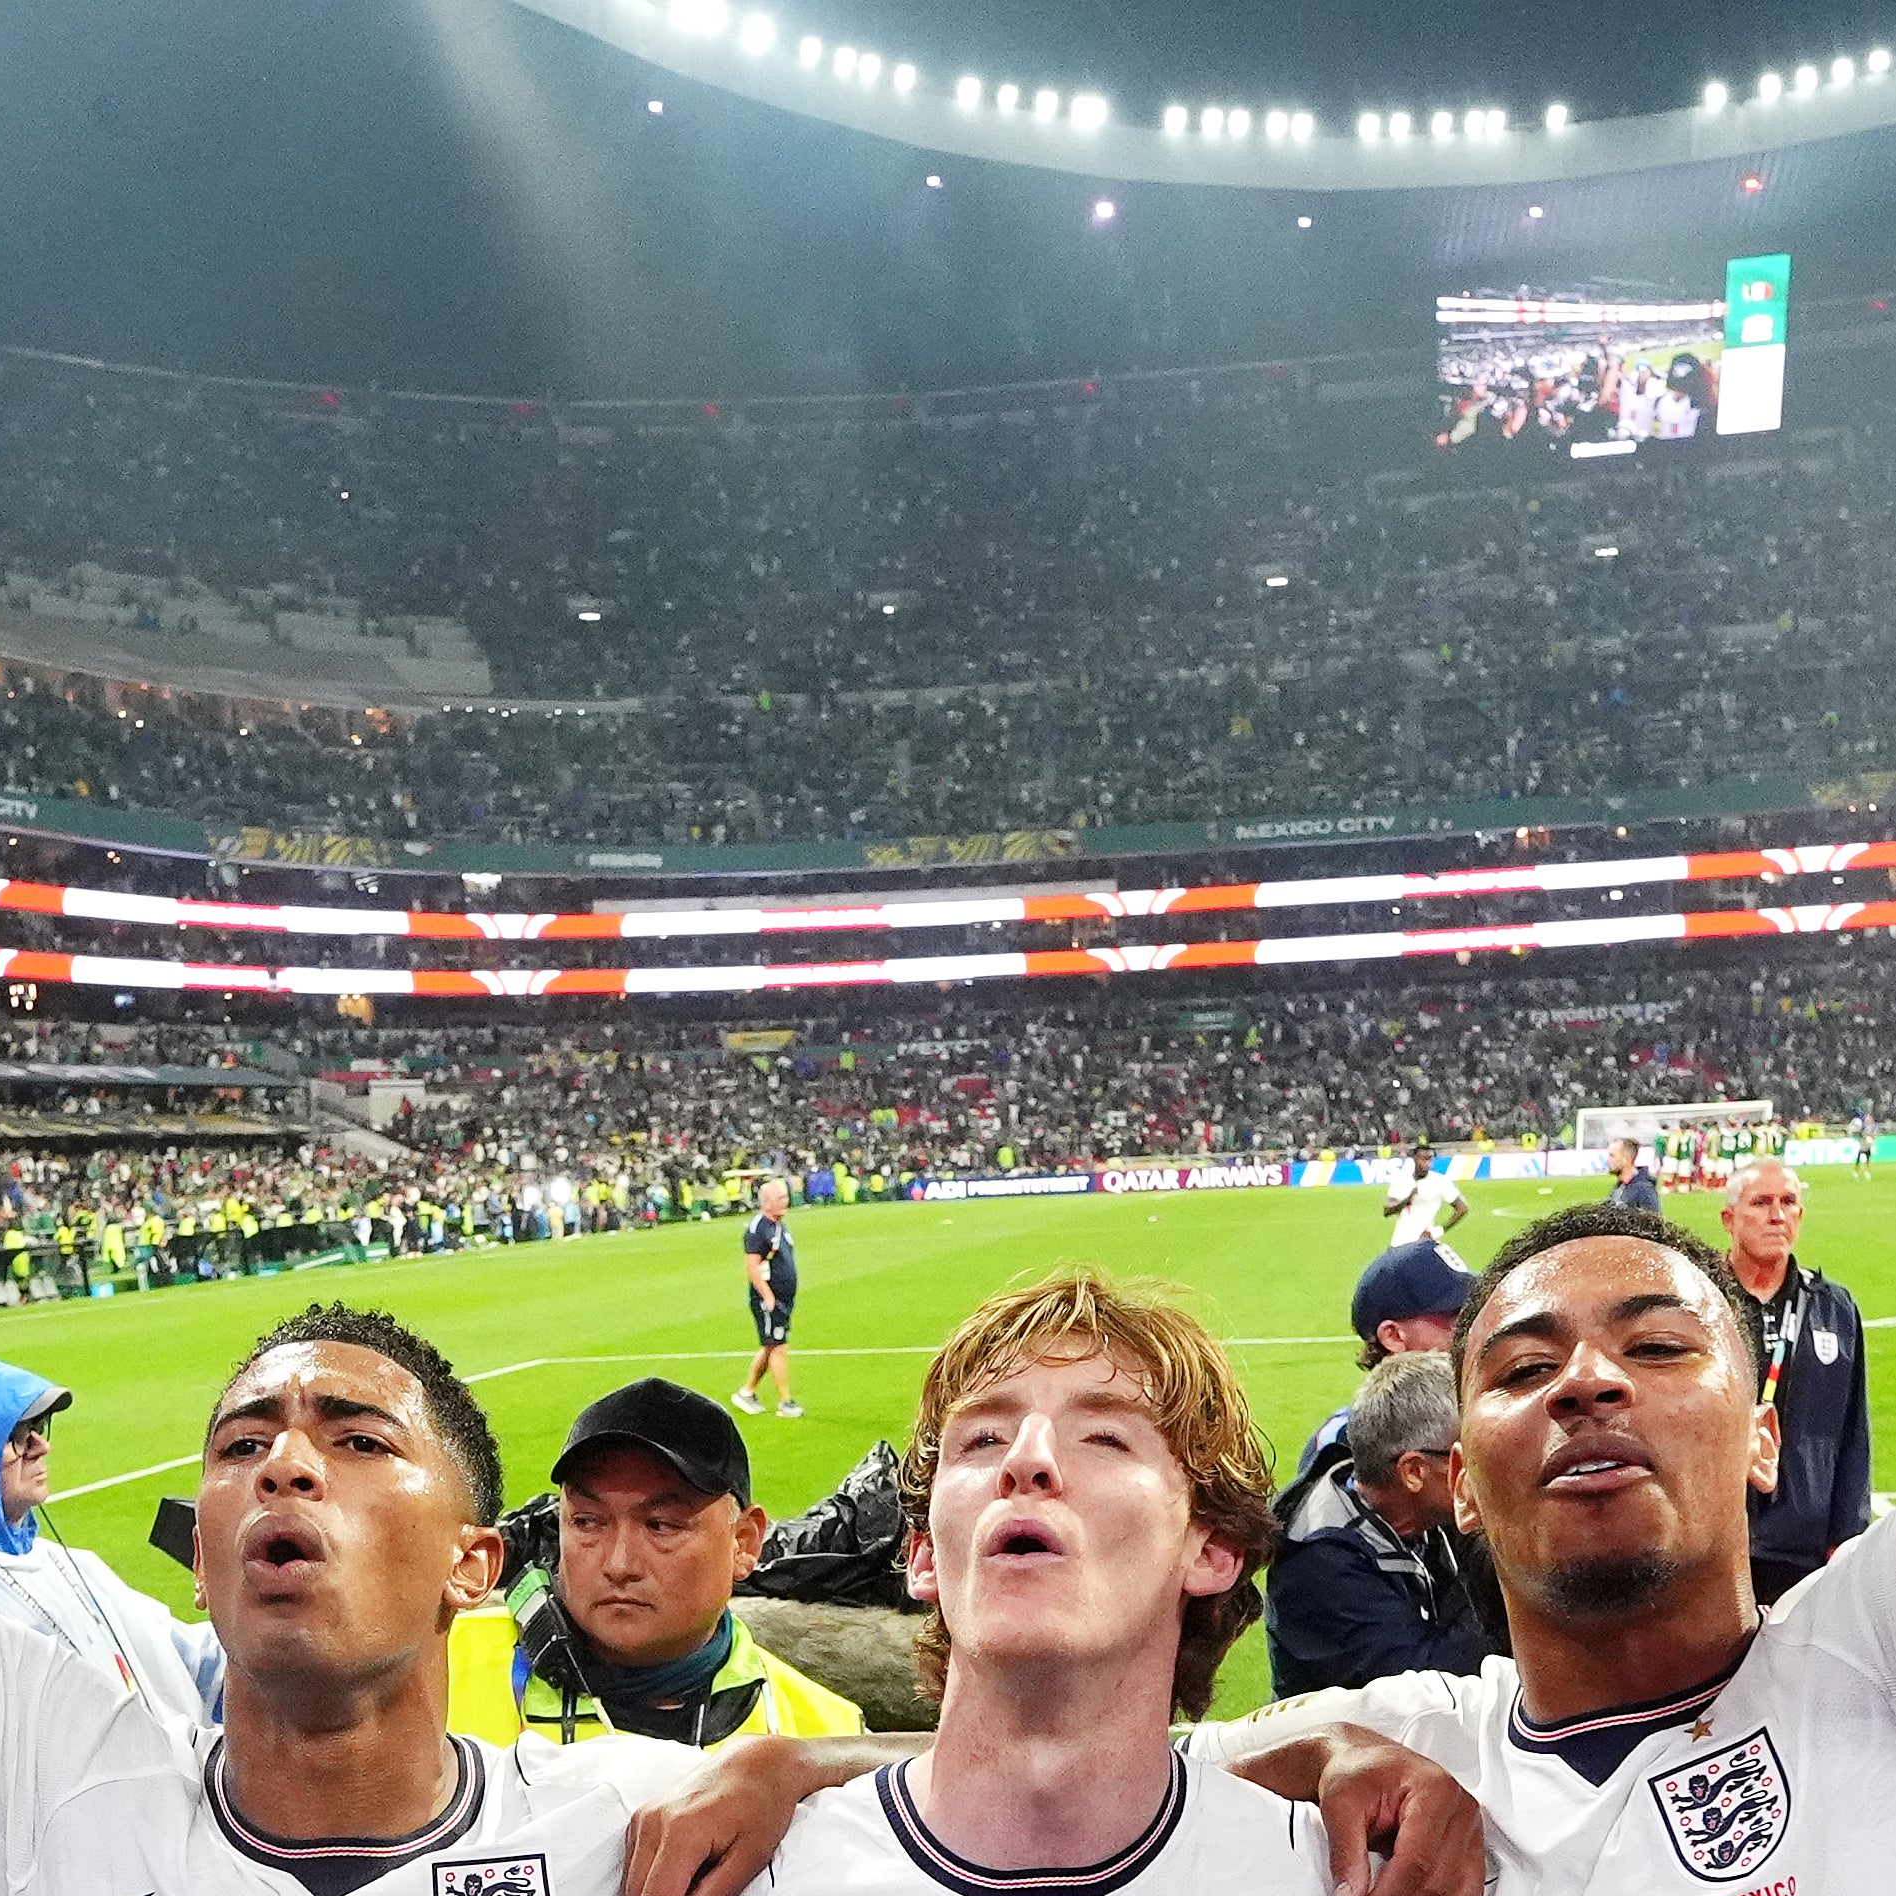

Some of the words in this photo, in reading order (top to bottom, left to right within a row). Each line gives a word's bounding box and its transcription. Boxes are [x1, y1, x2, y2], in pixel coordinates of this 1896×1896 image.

[1235, 819, 1333, 841] MEXICO
[1337, 815, 1396, 833] CITY
[1102, 1170, 1180, 1194] QATAR
[1185, 1164, 1284, 1189] AIRWAYS
